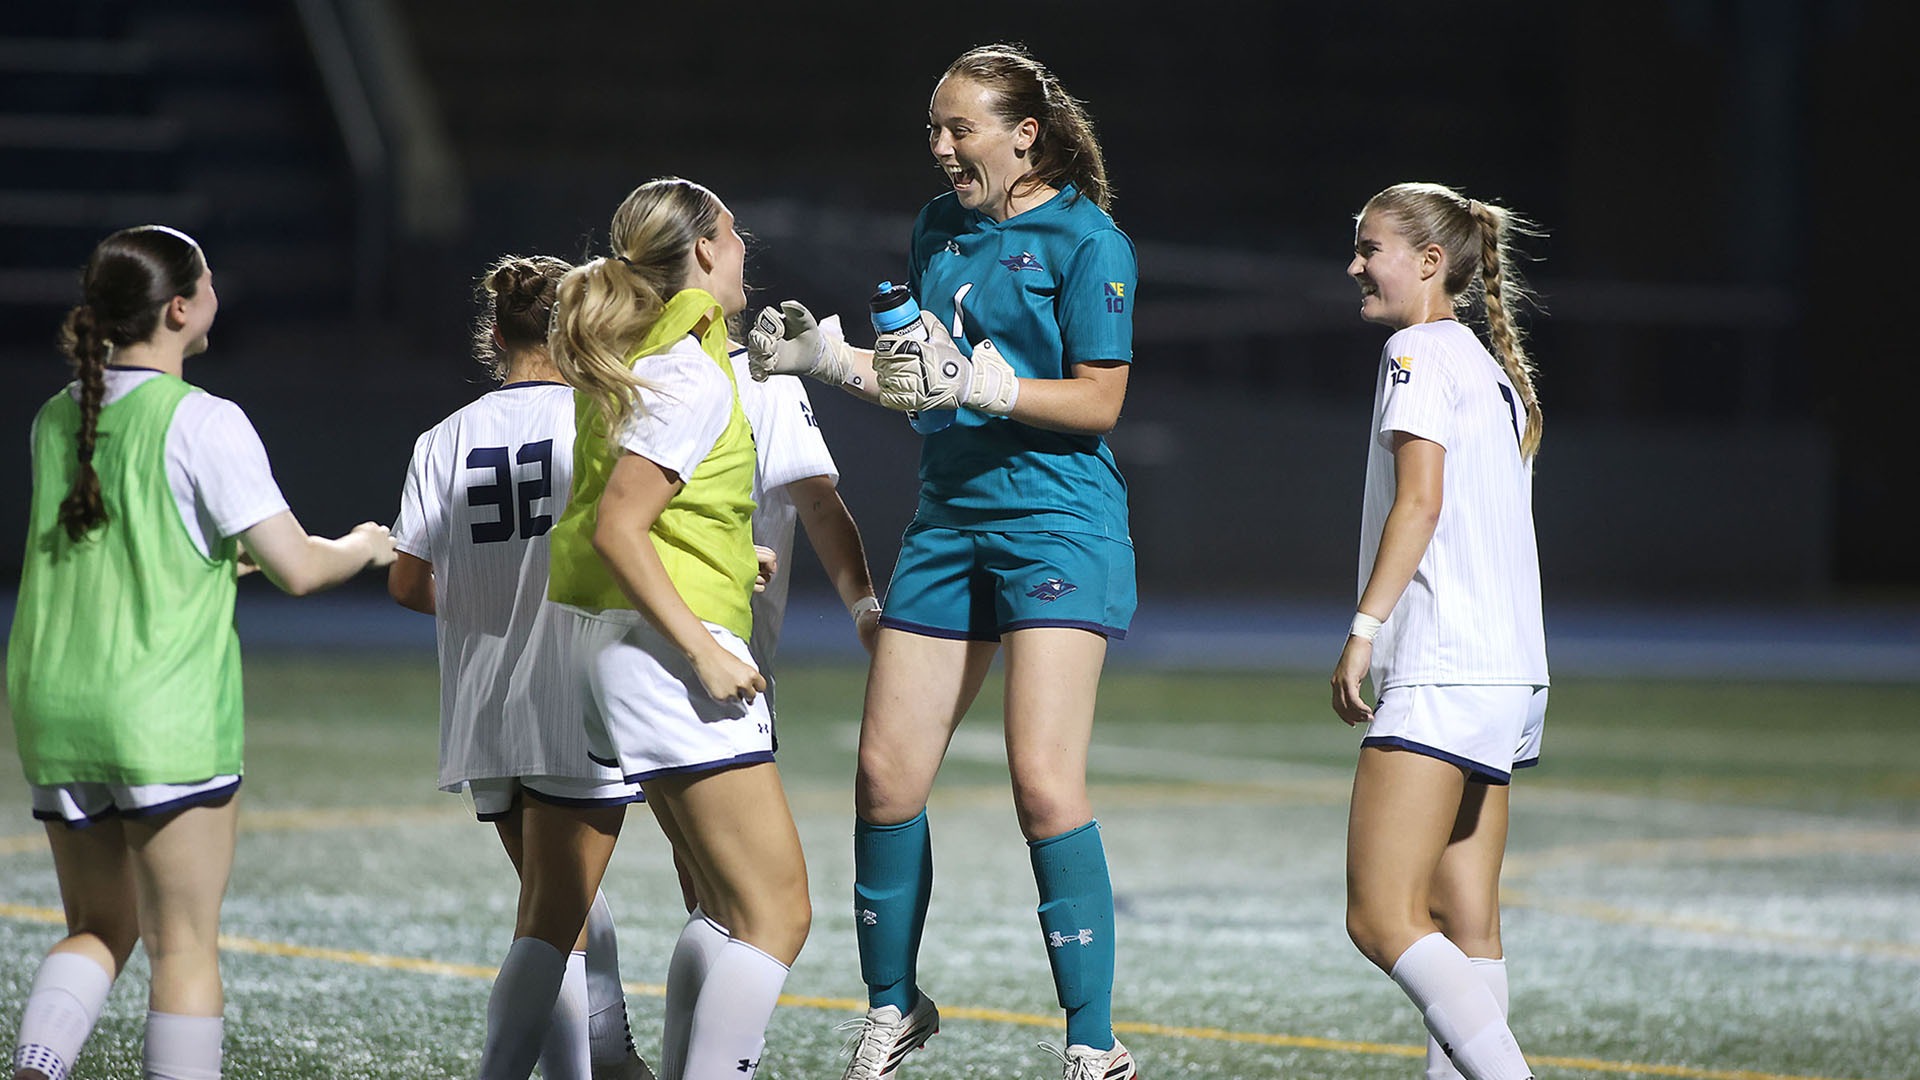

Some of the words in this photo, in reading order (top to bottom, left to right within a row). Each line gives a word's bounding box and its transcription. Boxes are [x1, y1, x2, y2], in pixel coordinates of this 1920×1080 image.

[1105, 297, 1124, 314] 10
[1391, 369, 1411, 387] 10
[466, 438, 553, 544] 32
